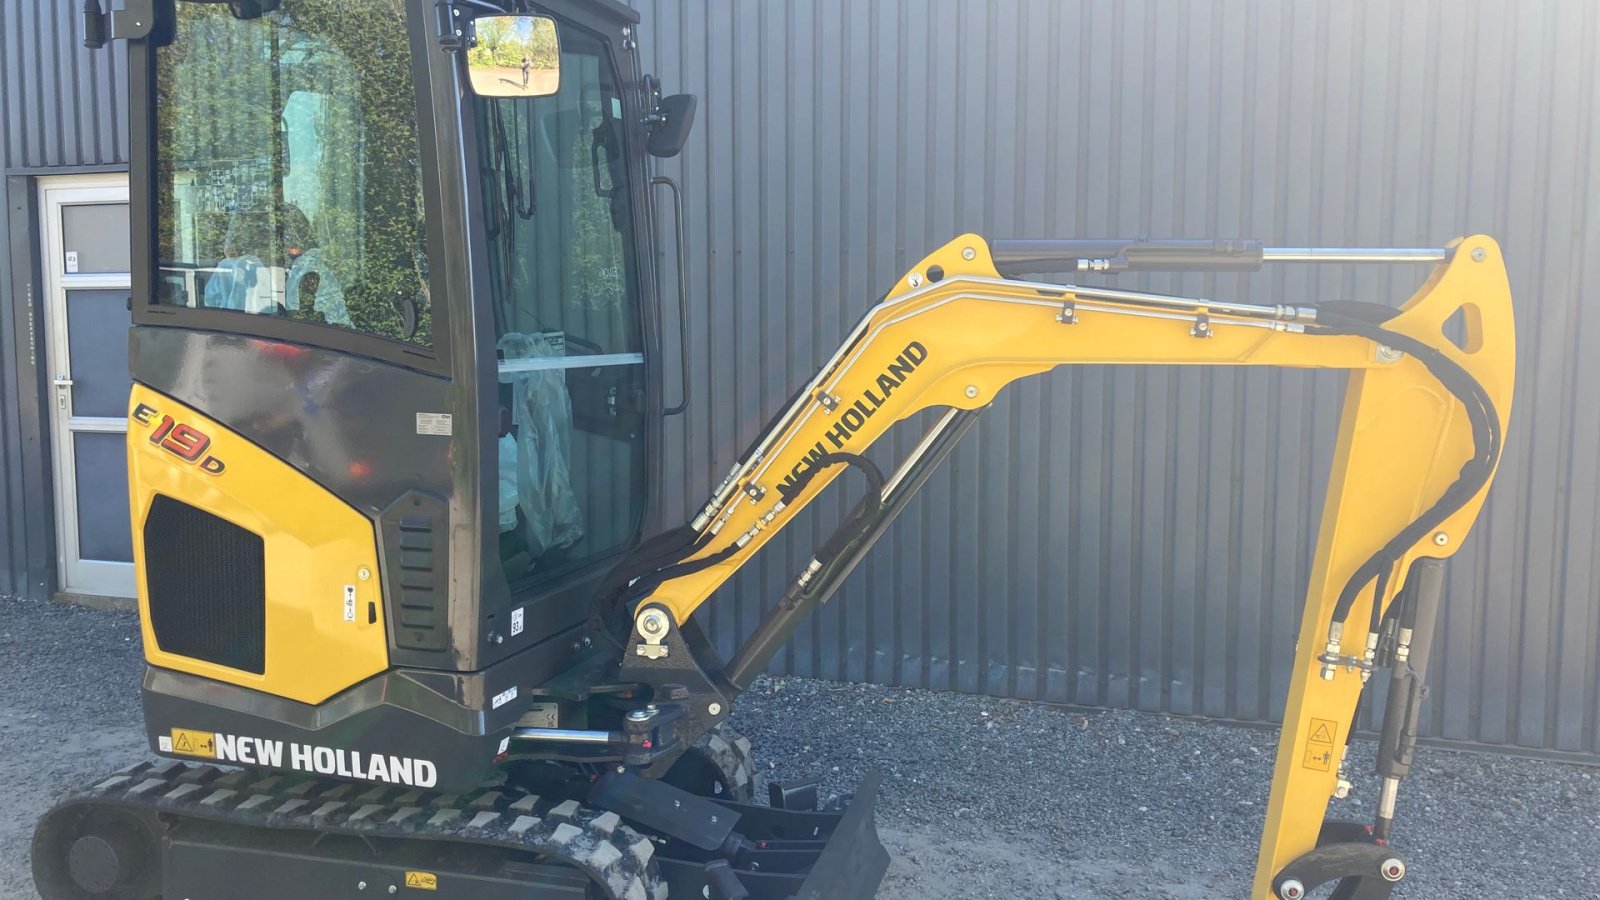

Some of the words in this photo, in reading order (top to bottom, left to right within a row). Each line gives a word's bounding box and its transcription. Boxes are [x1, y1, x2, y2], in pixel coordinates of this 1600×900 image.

[825, 341, 928, 449] HOLLAND
[214, 733, 284, 768] NEW
[290, 742, 438, 789] HOLLAND
